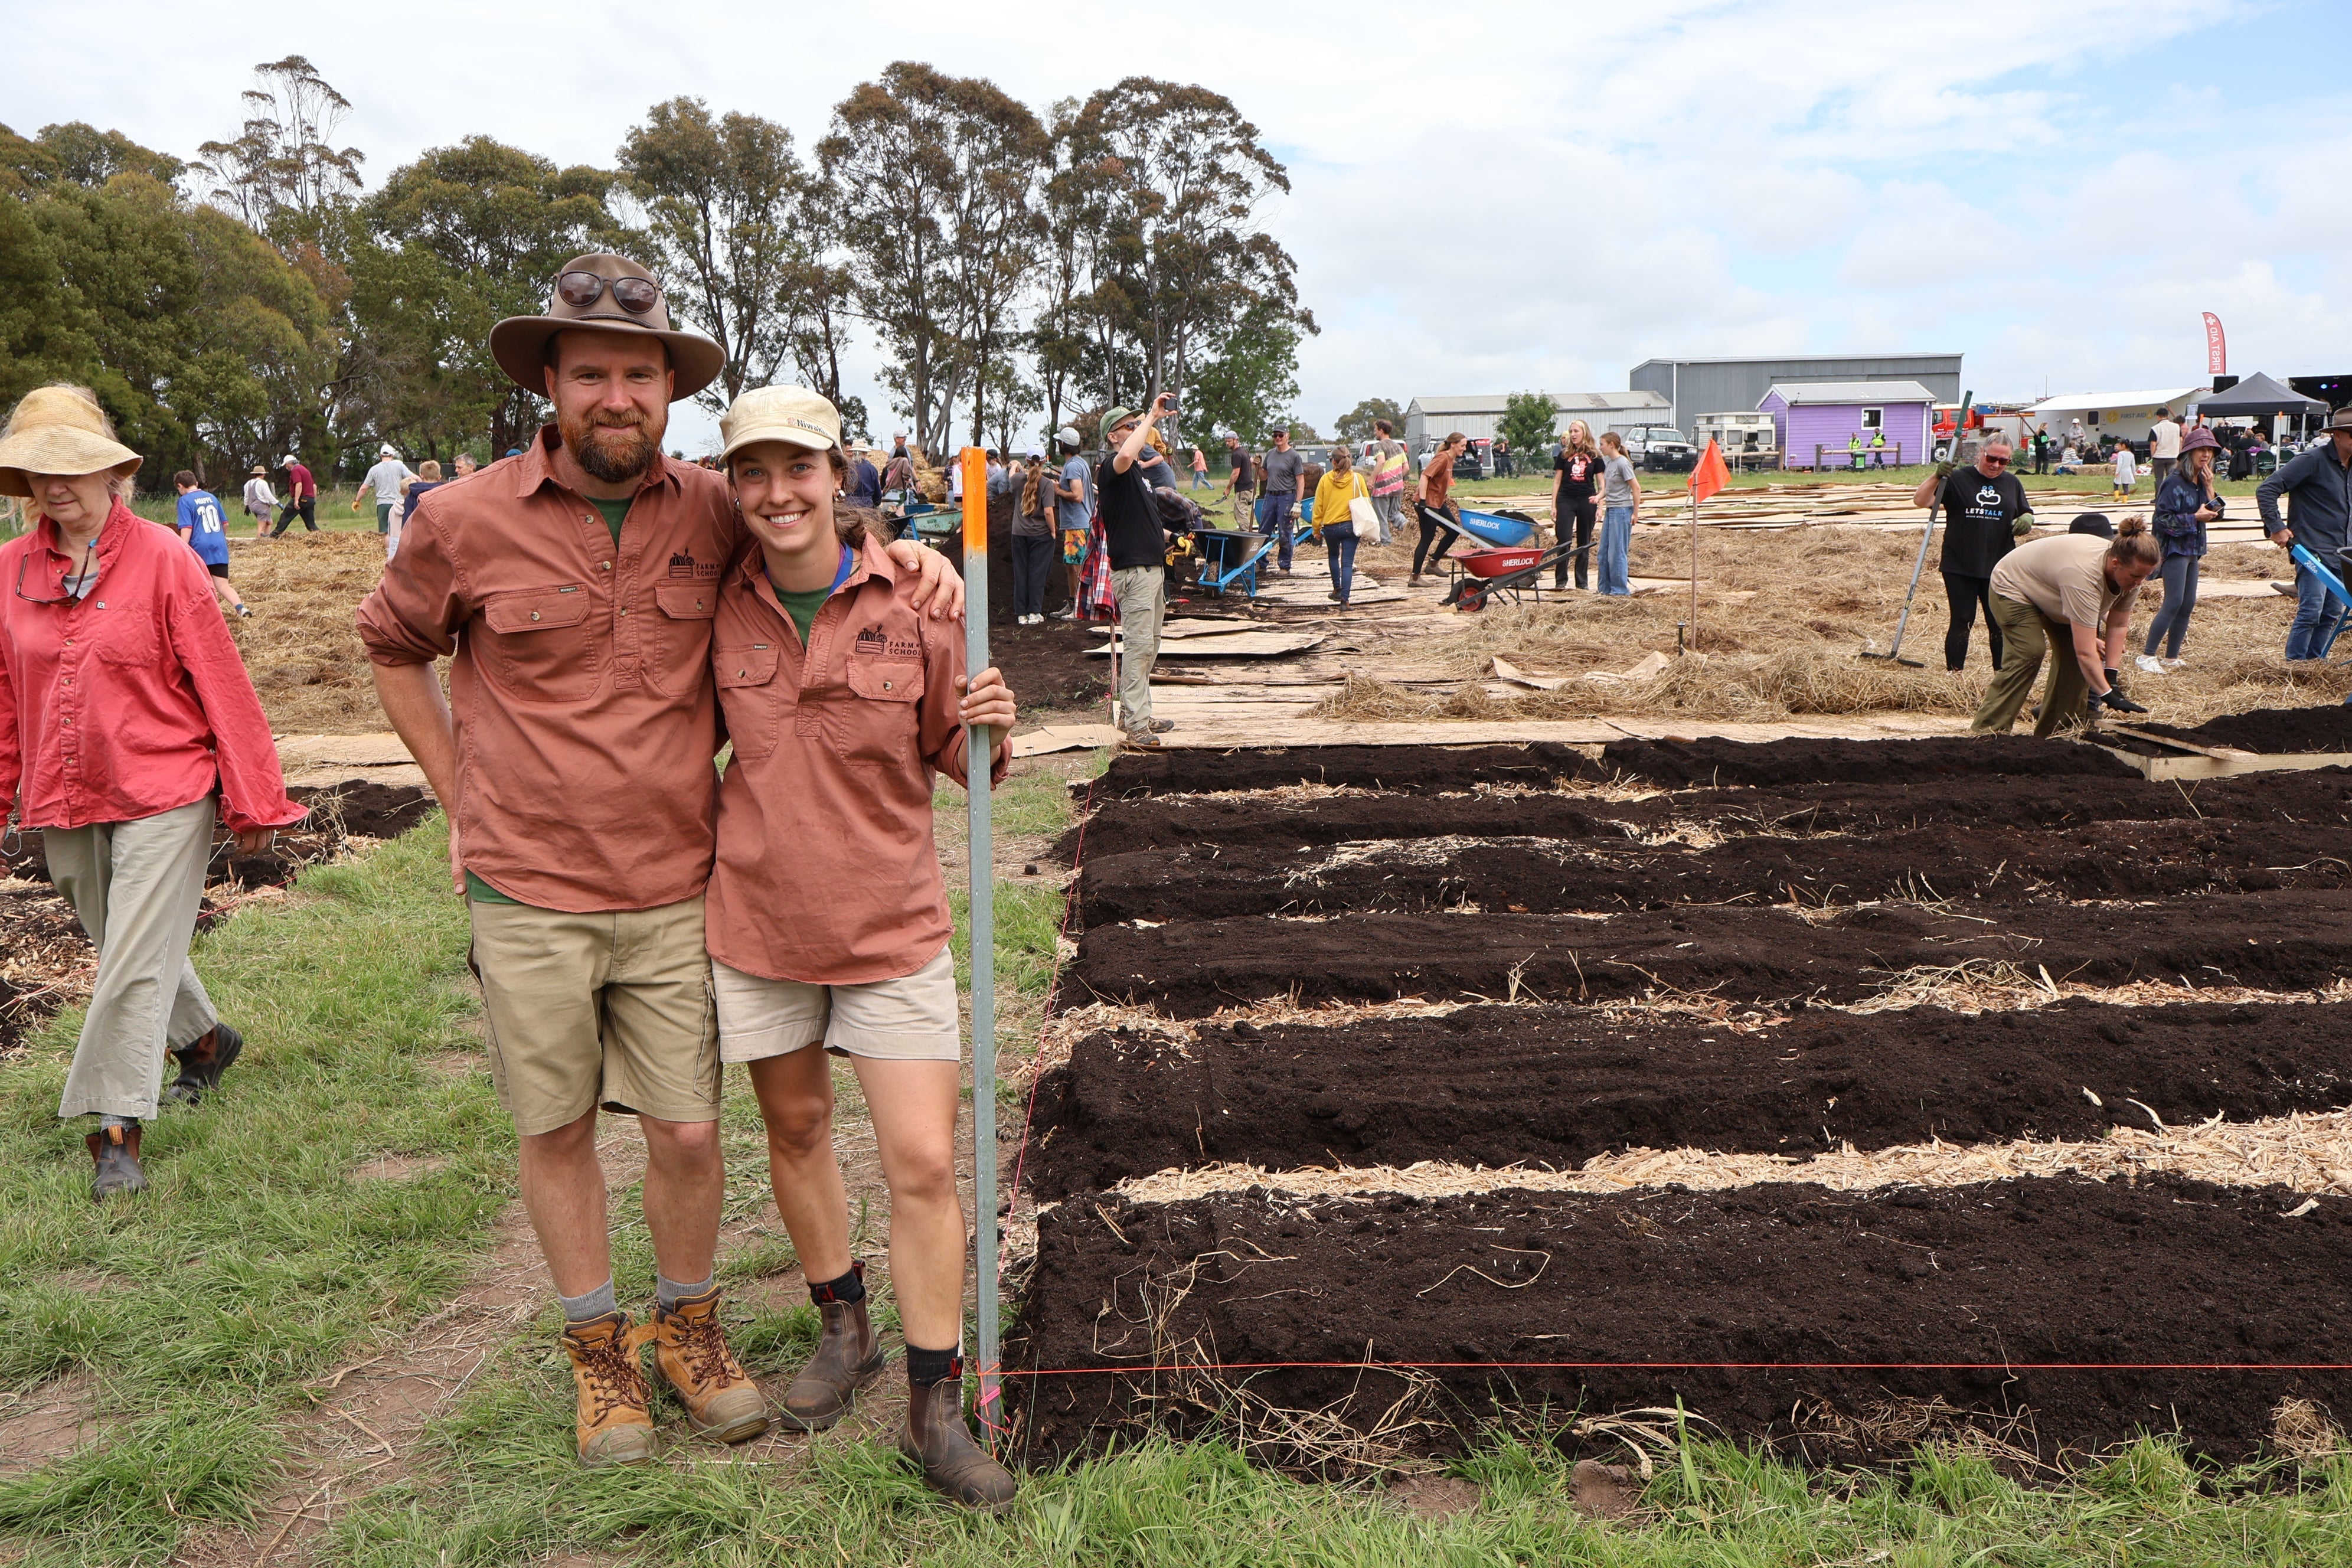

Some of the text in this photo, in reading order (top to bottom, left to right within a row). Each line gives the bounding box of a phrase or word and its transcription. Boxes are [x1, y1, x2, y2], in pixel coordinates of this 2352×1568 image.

[796, 419, 825, 435] Niwaki
[1965, 508, 2003, 517] LETSTALK
[197, 504, 220, 534] 10
[1469, 518, 1500, 530] SHERLOCK
[1502, 557, 1534, 567] SHERLOCK
